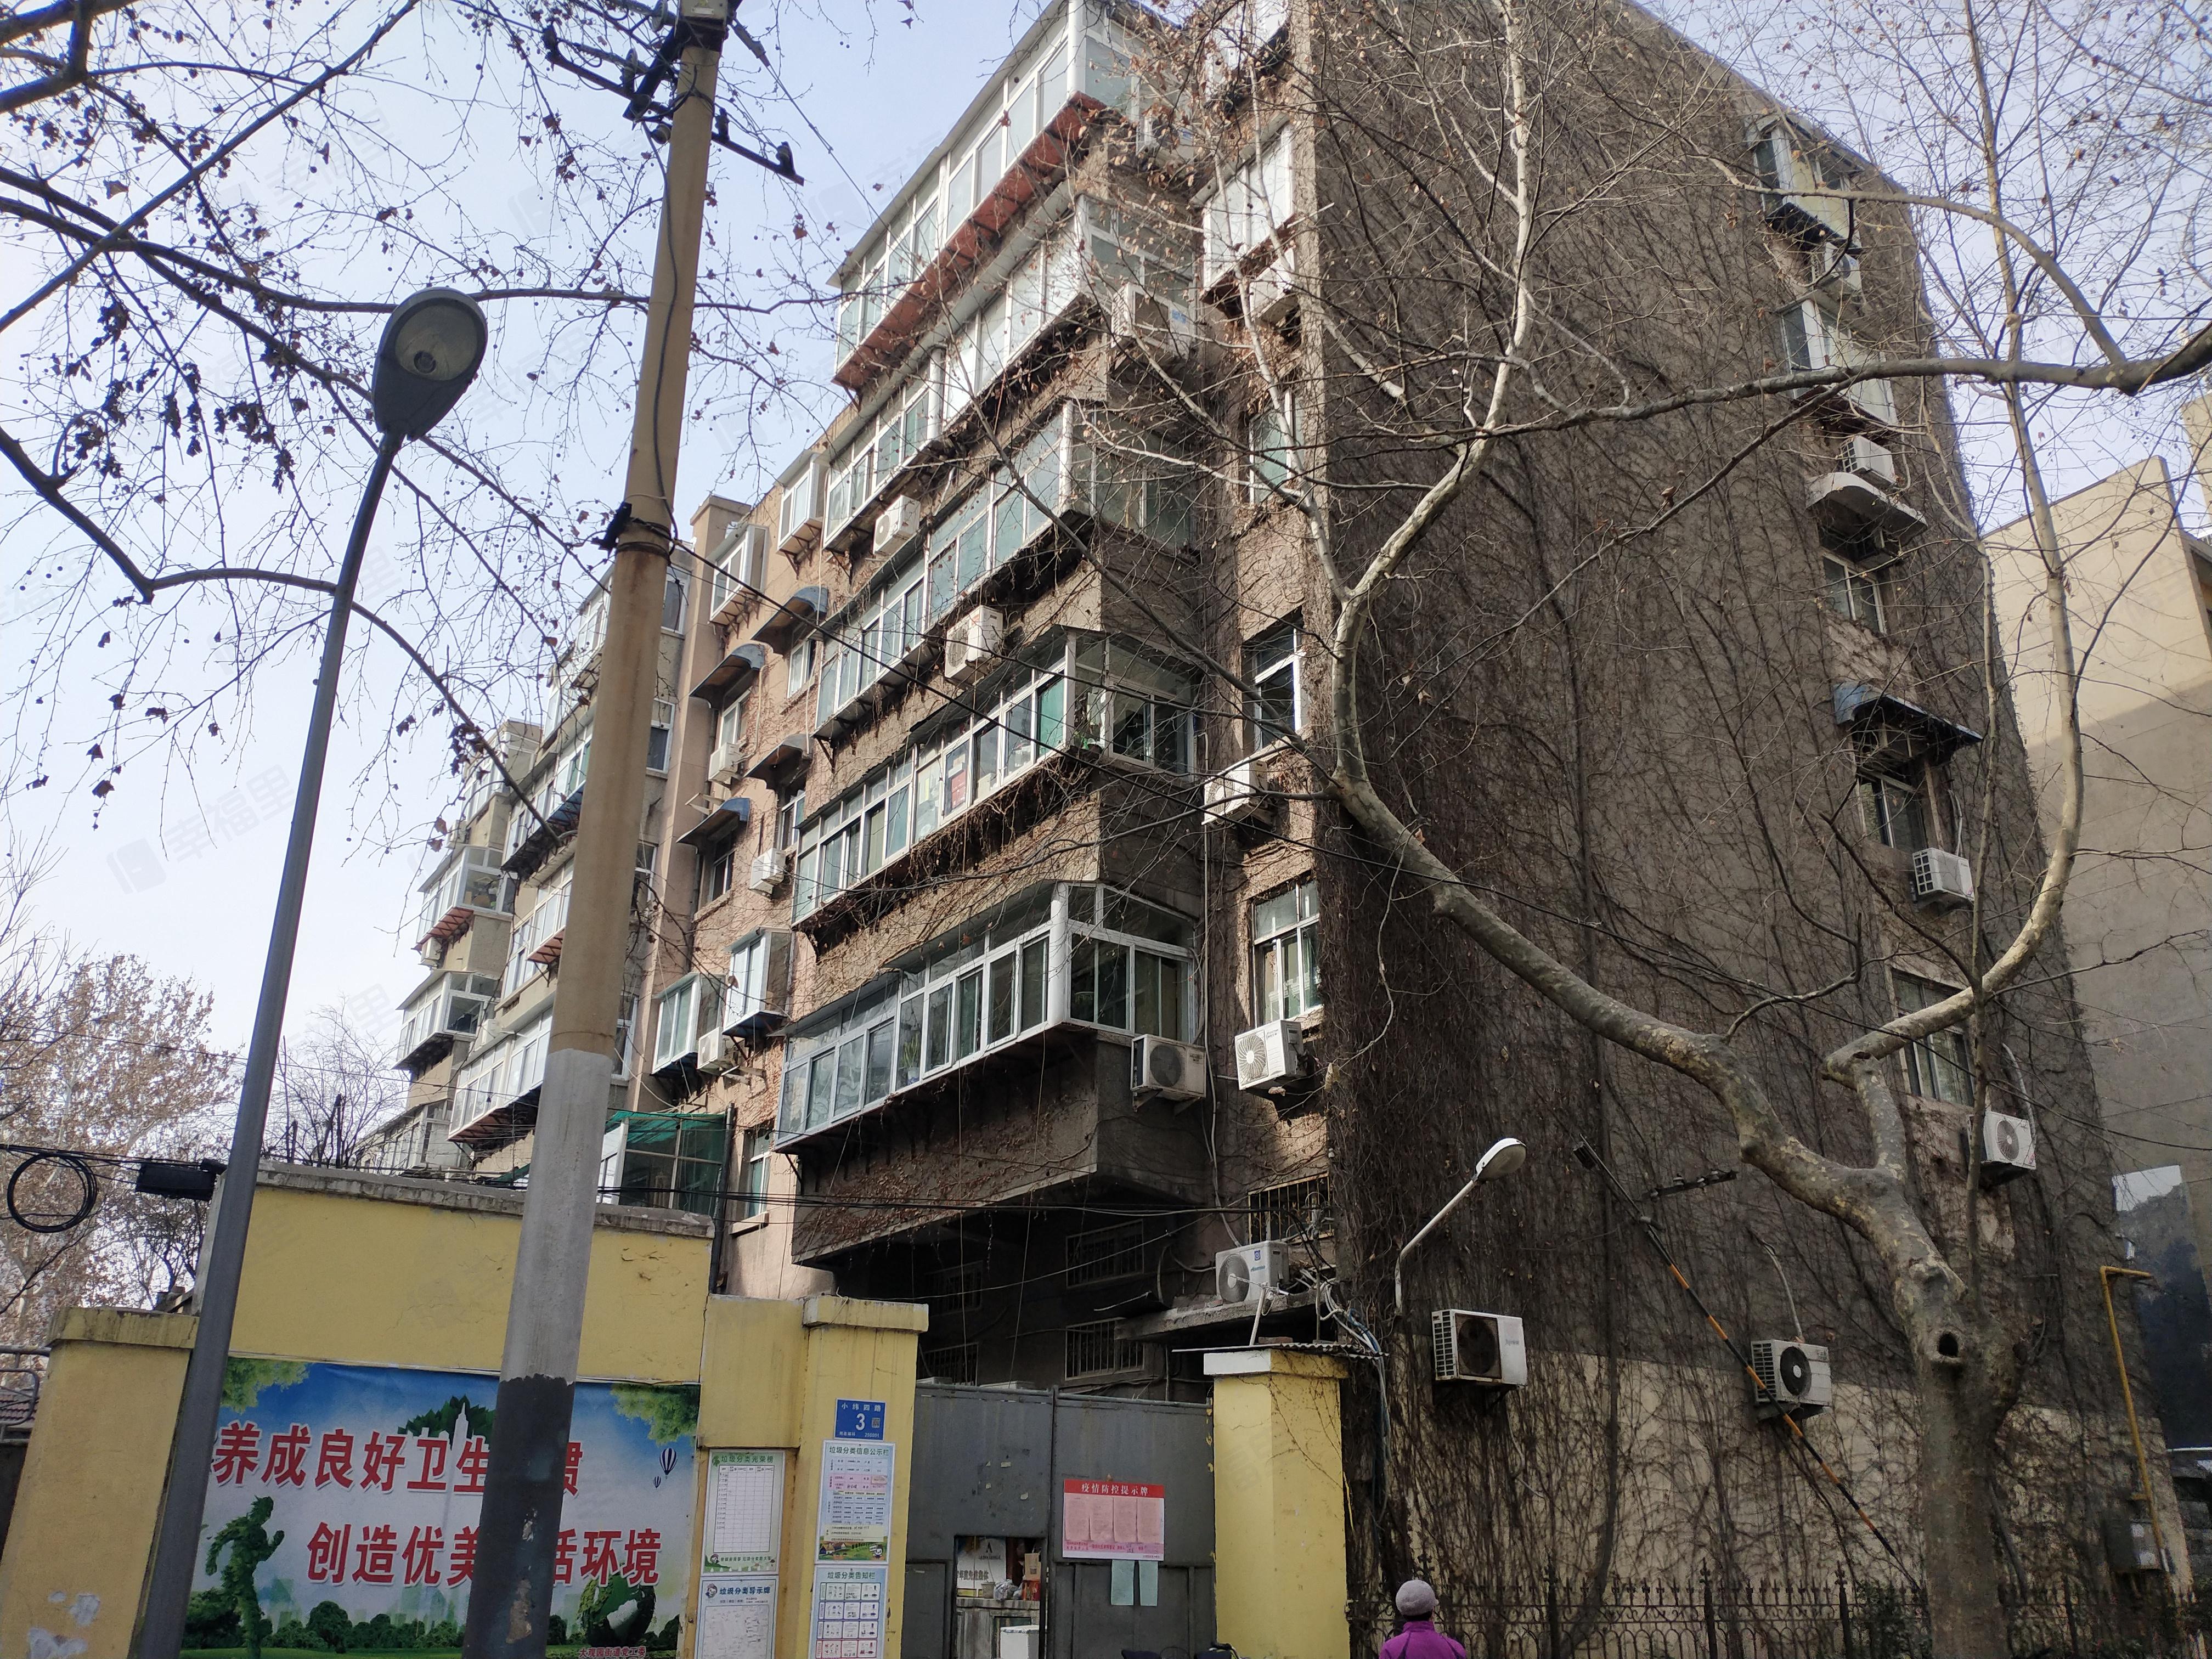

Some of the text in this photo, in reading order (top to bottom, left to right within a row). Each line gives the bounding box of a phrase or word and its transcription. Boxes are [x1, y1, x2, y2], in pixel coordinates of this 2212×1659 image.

[841, 1402, 881, 1412] 小纬四路
[855, 1413, 865, 1431] 3
[829, 1446, 889, 1456] 垃圾分类信息公示栏
[212, 1421, 583, 1497] 养成良好卫生
[721, 1455, 774, 1463] 垃圾分类光荣榜
[1081, 1482, 1149, 1496] 疫情防控提示牌
[307, 1522, 661, 1587] 创造优美活环境
[827, 1571, 876, 1579] 垃圾分类告知栏
[579, 1645, 646, 1657] 大观园街道党工委
